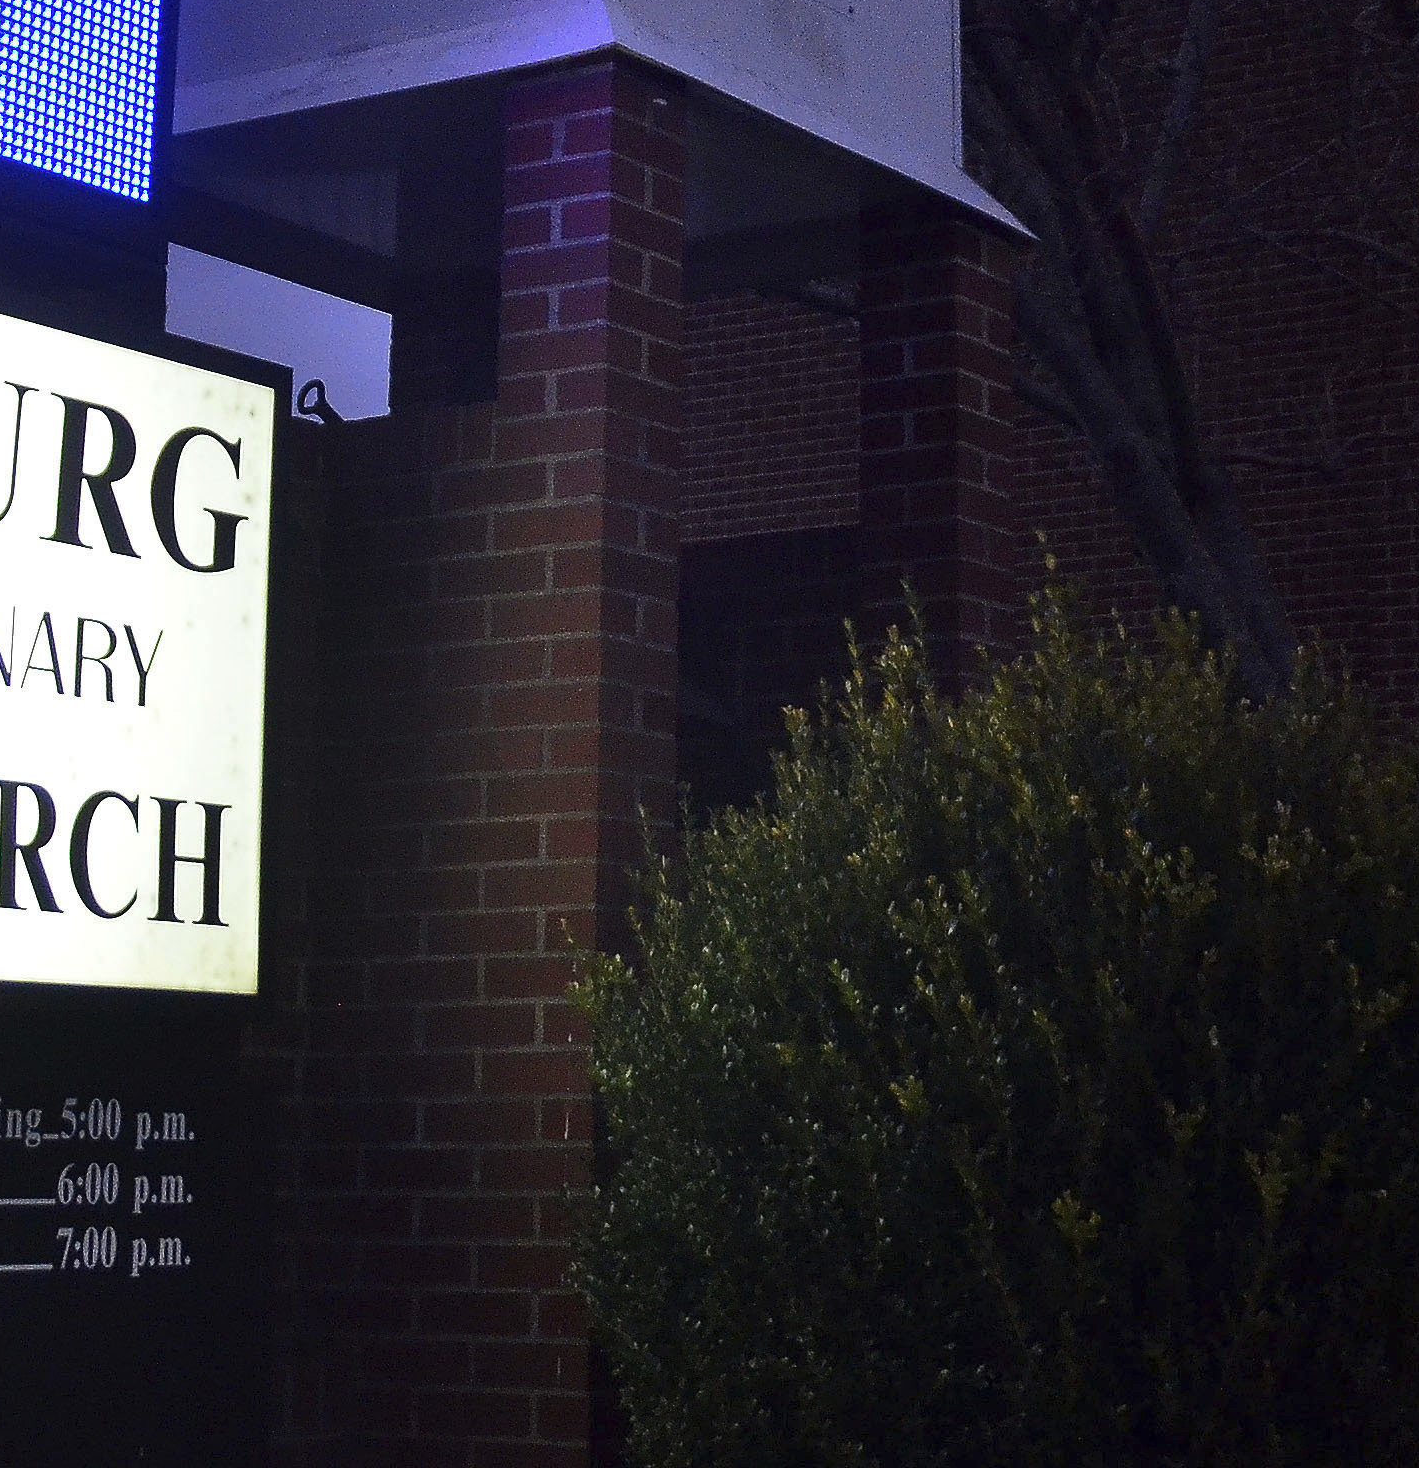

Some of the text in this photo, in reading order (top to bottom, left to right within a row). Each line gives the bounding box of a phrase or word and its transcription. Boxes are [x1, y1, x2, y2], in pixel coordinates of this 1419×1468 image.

[61, 1097, 123, 1141] 5:00
[134, 1111, 195, 1150] p.m.
[56, 1162, 120, 1206] 6:00
[132, 1177, 194, 1214] p.m.
[55, 1226, 119, 1272] 7:00
[130, 1240, 192, 1277] p.m.
